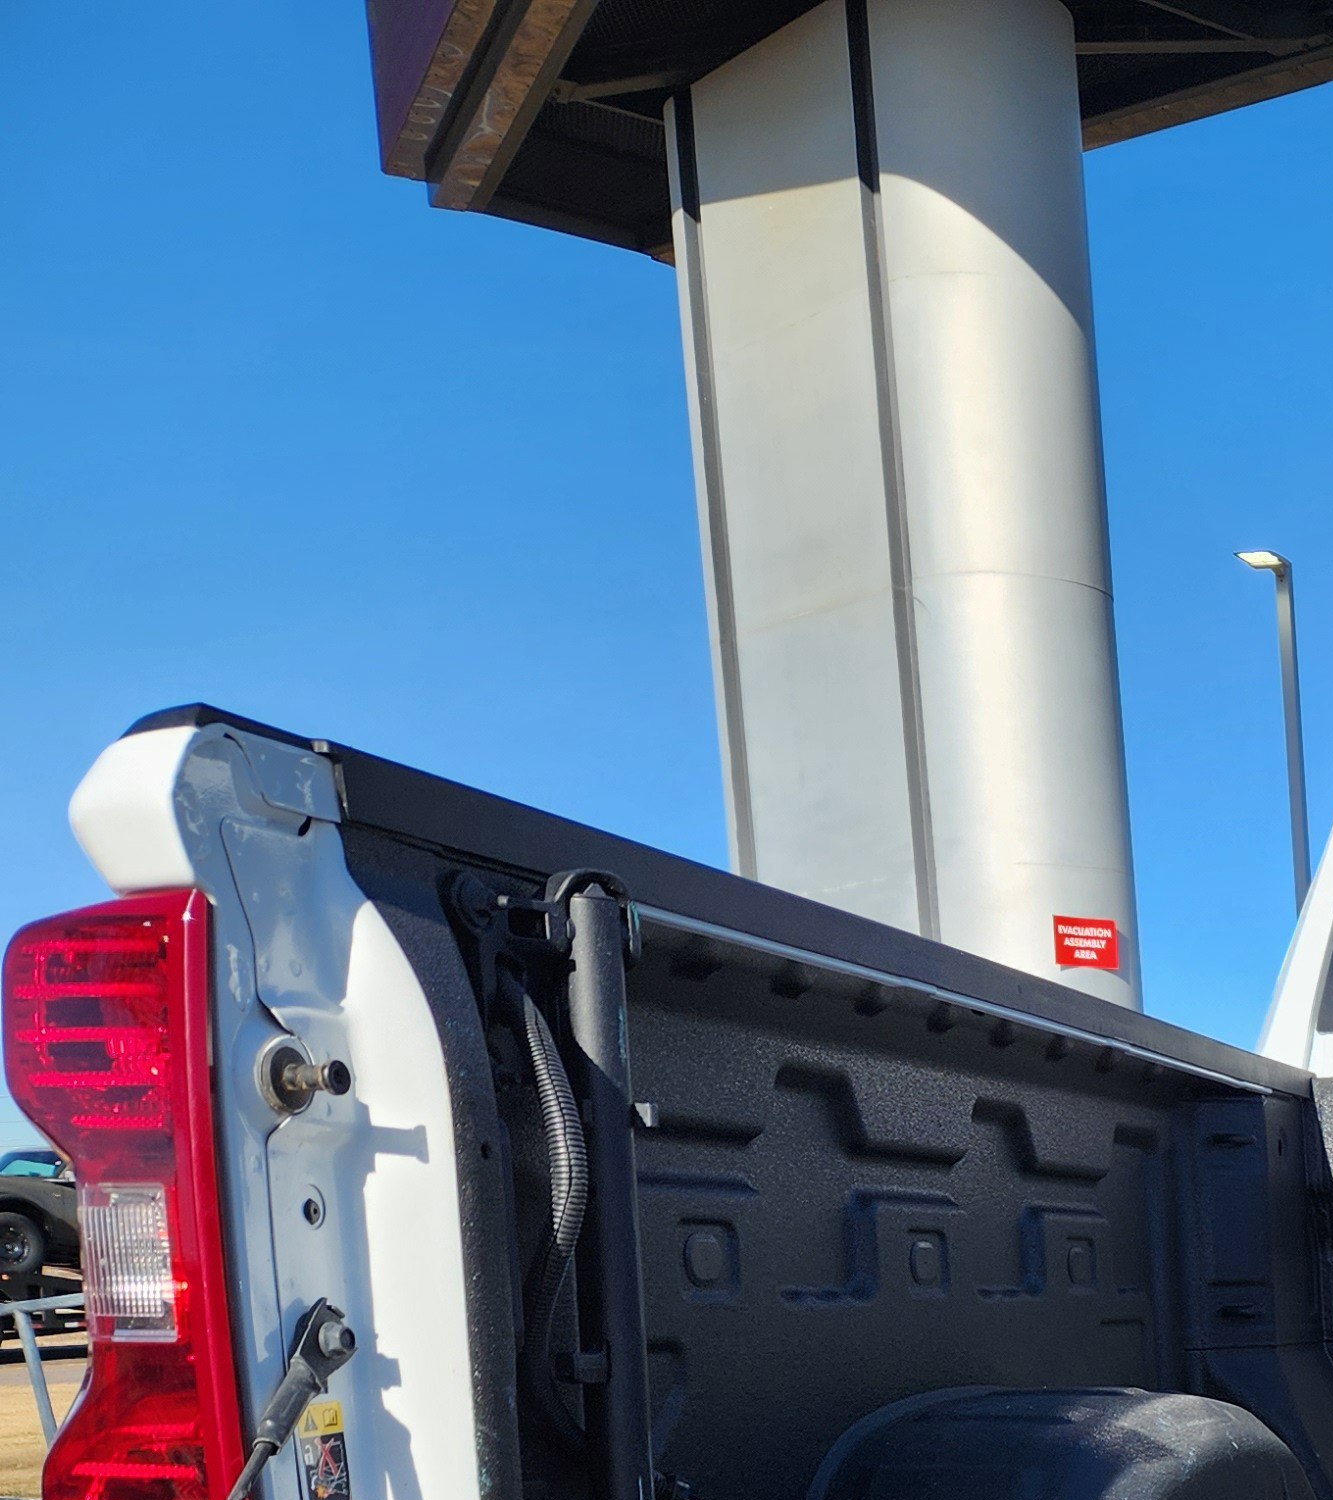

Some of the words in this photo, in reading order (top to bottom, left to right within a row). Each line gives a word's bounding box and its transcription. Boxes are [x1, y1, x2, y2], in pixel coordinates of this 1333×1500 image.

[1058, 925, 1112, 938] EVACUATION
[1064, 937, 1106, 949] ASSEMBLY
[1074, 949, 1098, 960] AREA
